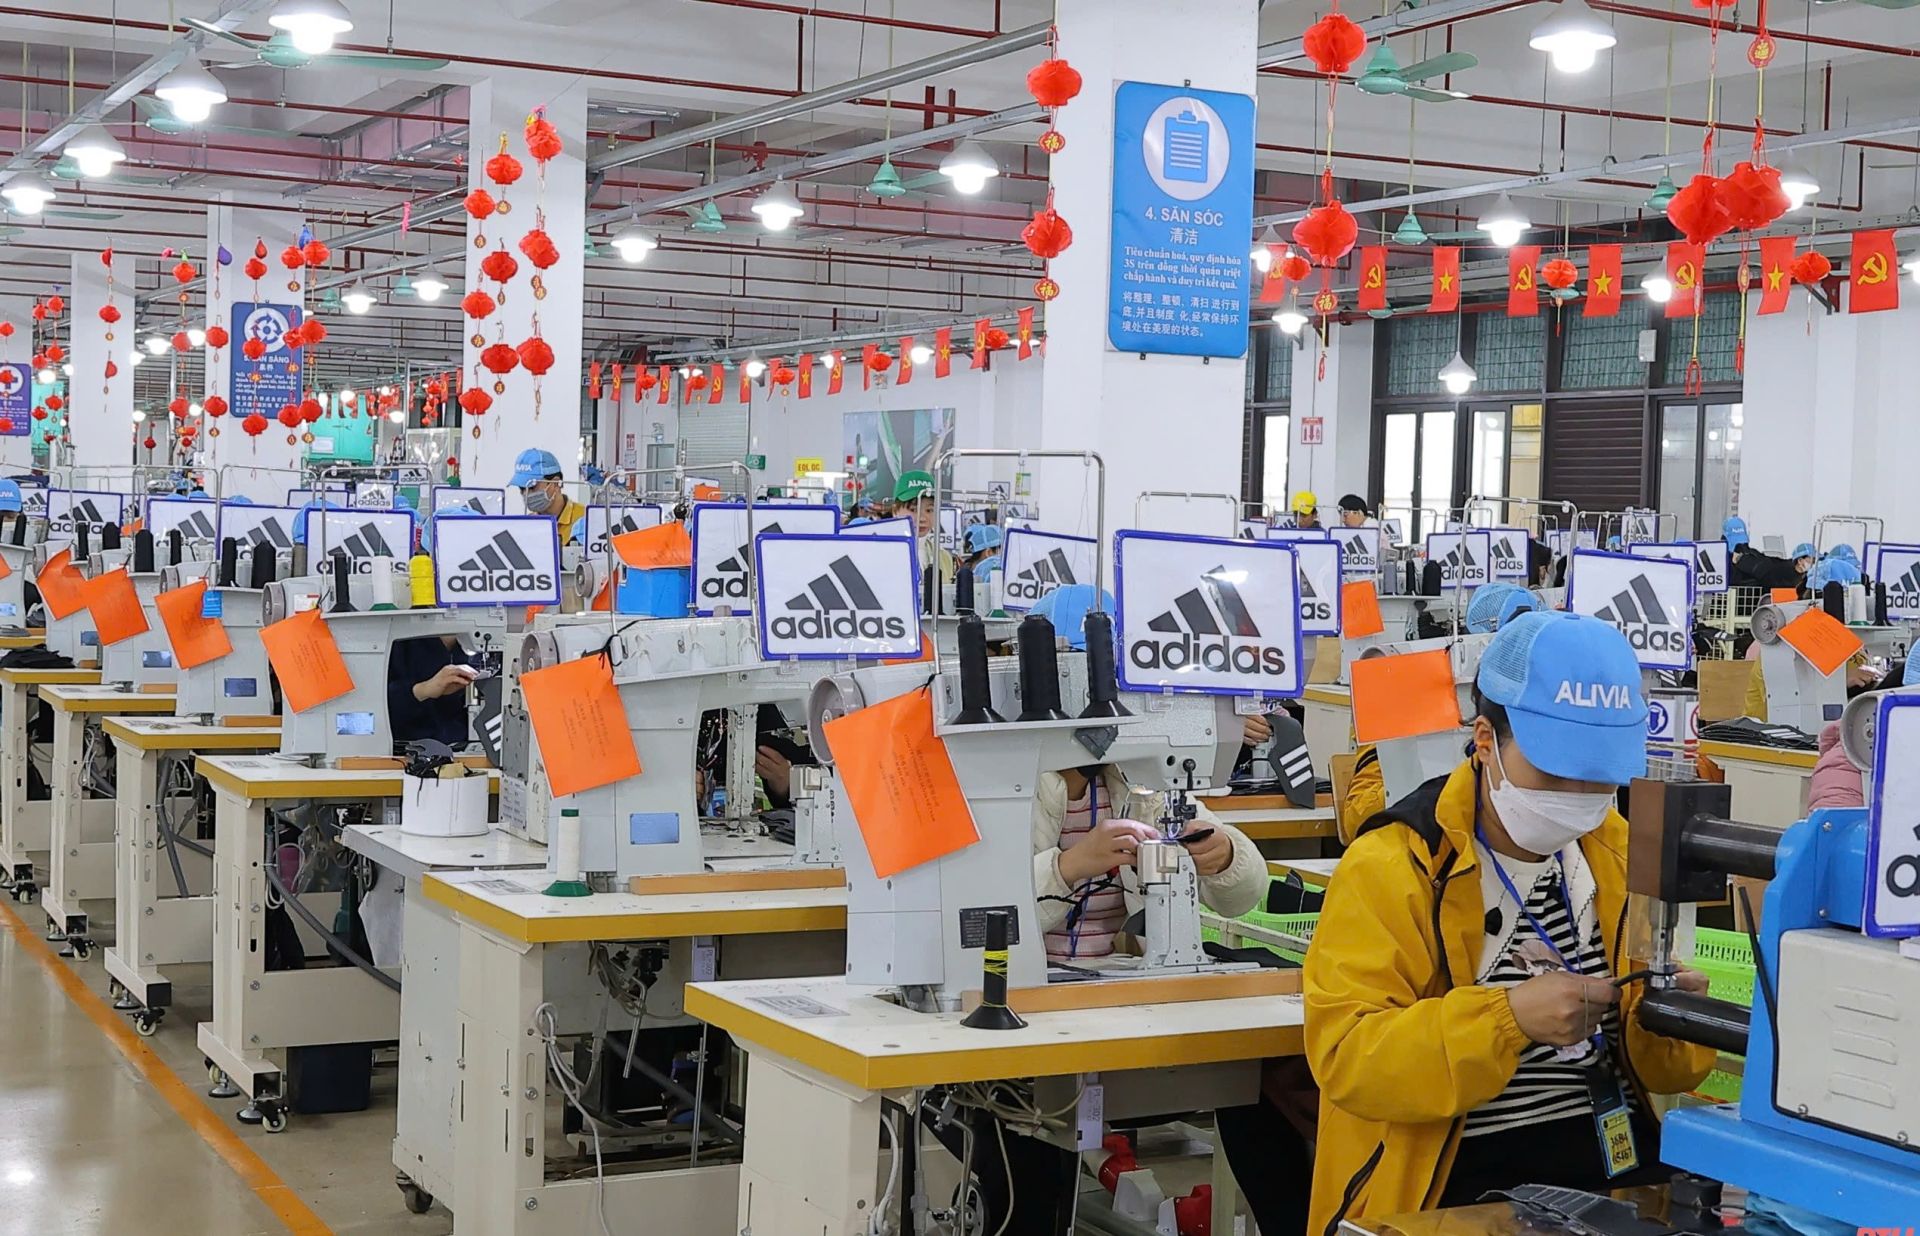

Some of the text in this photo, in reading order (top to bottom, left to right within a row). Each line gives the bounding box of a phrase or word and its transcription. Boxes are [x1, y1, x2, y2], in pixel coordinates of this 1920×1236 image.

[1145, 206, 1224, 227] 4. SĂN SÓC
[1170, 227, 1199, 245] 清洁
[1124, 258, 1134, 268] 3S
[1190, 253, 1205, 264] quy
[1178, 276, 1194, 288] duy
[358, 499, 391, 507] adidas
[1342, 553, 1376, 566] didas
[1495, 557, 1524, 570] idas
[447, 569, 553, 593] adidas
[1441, 566, 1484, 581] didas
[1885, 591, 1920, 609] adid
[771, 610, 907, 640] adidas
[1130, 633, 1286, 676] adidas
[1554, 680, 1632, 710] ALIVIA
